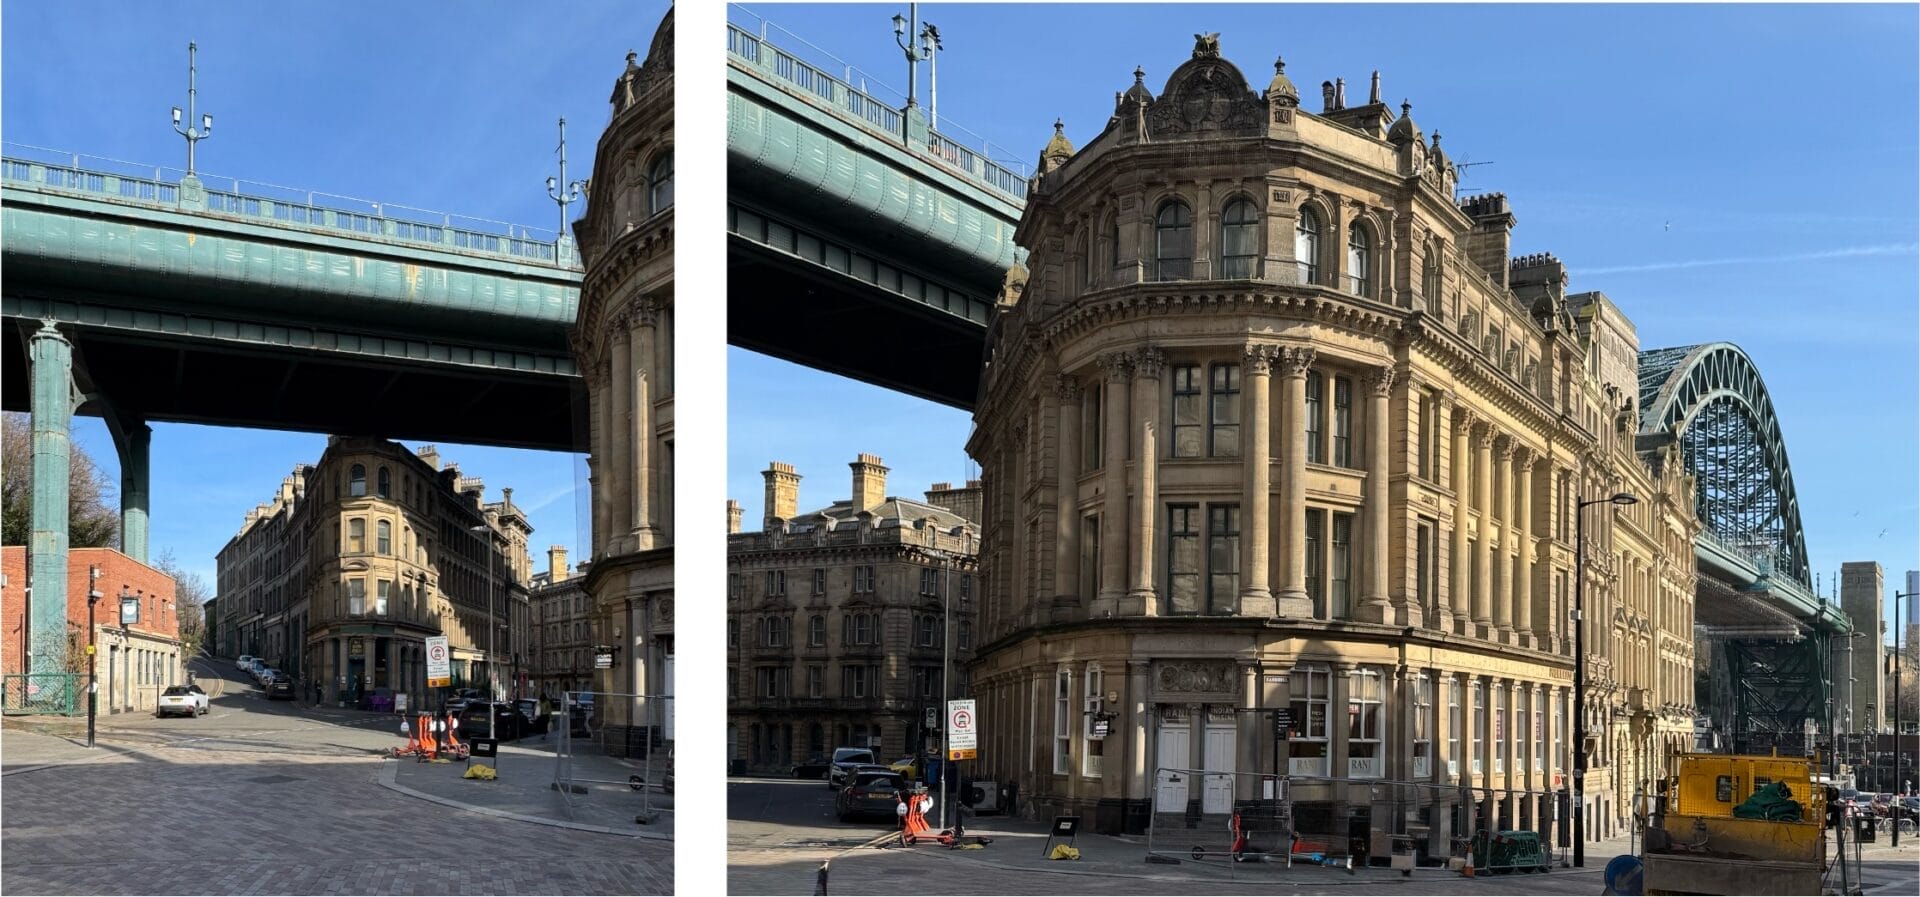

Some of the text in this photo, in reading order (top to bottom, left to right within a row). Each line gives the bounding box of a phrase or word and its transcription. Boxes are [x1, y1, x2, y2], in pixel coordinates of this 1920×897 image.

[1165, 708, 1188, 718] RANI
[1296, 759, 1318, 769] RANI
[1351, 759, 1372, 769] RANI
